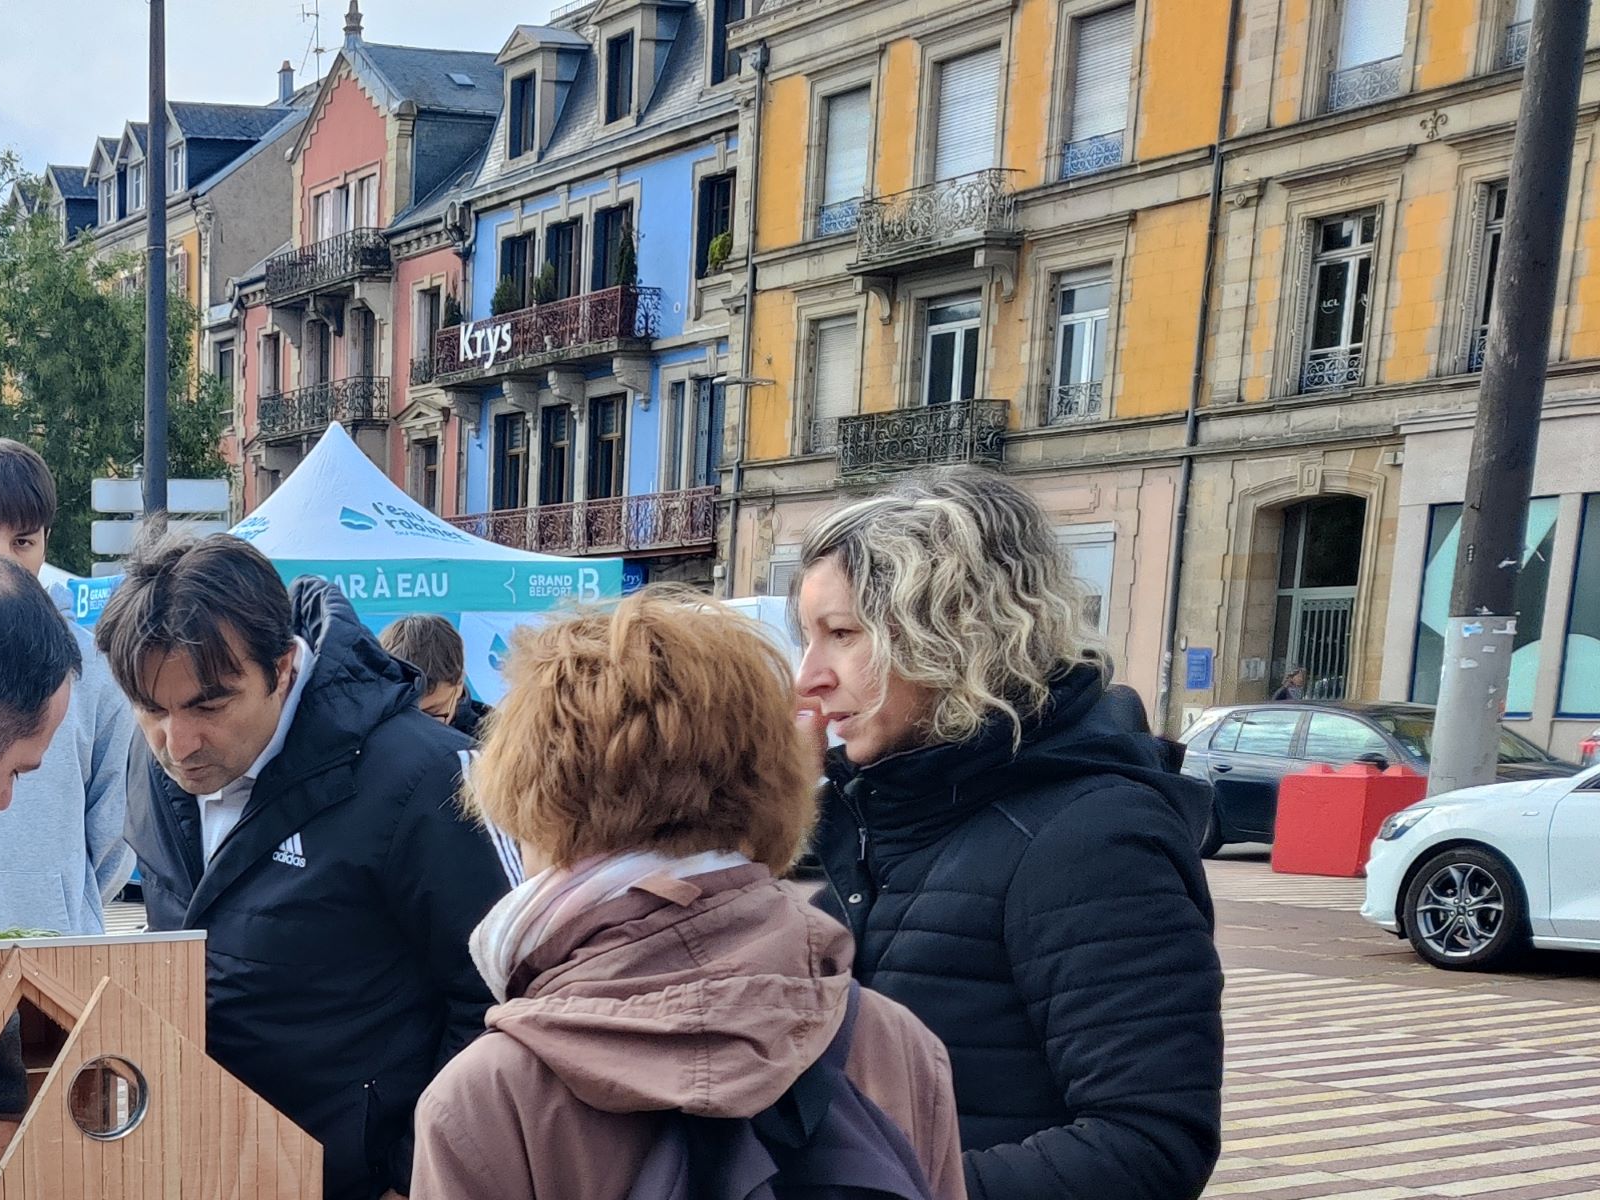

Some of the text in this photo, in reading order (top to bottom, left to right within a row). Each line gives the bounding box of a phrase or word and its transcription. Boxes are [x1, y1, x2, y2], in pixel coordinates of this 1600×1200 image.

[1322, 298, 1340, 308] LCL
[459, 321, 512, 370] Krys
[385, 519, 471, 543] robinet
[317, 567, 449, 599] AR À EAU
[528, 574, 573, 586] GRAND
[528, 586, 573, 597] BELFORT
[271, 850, 307, 868] adidas
